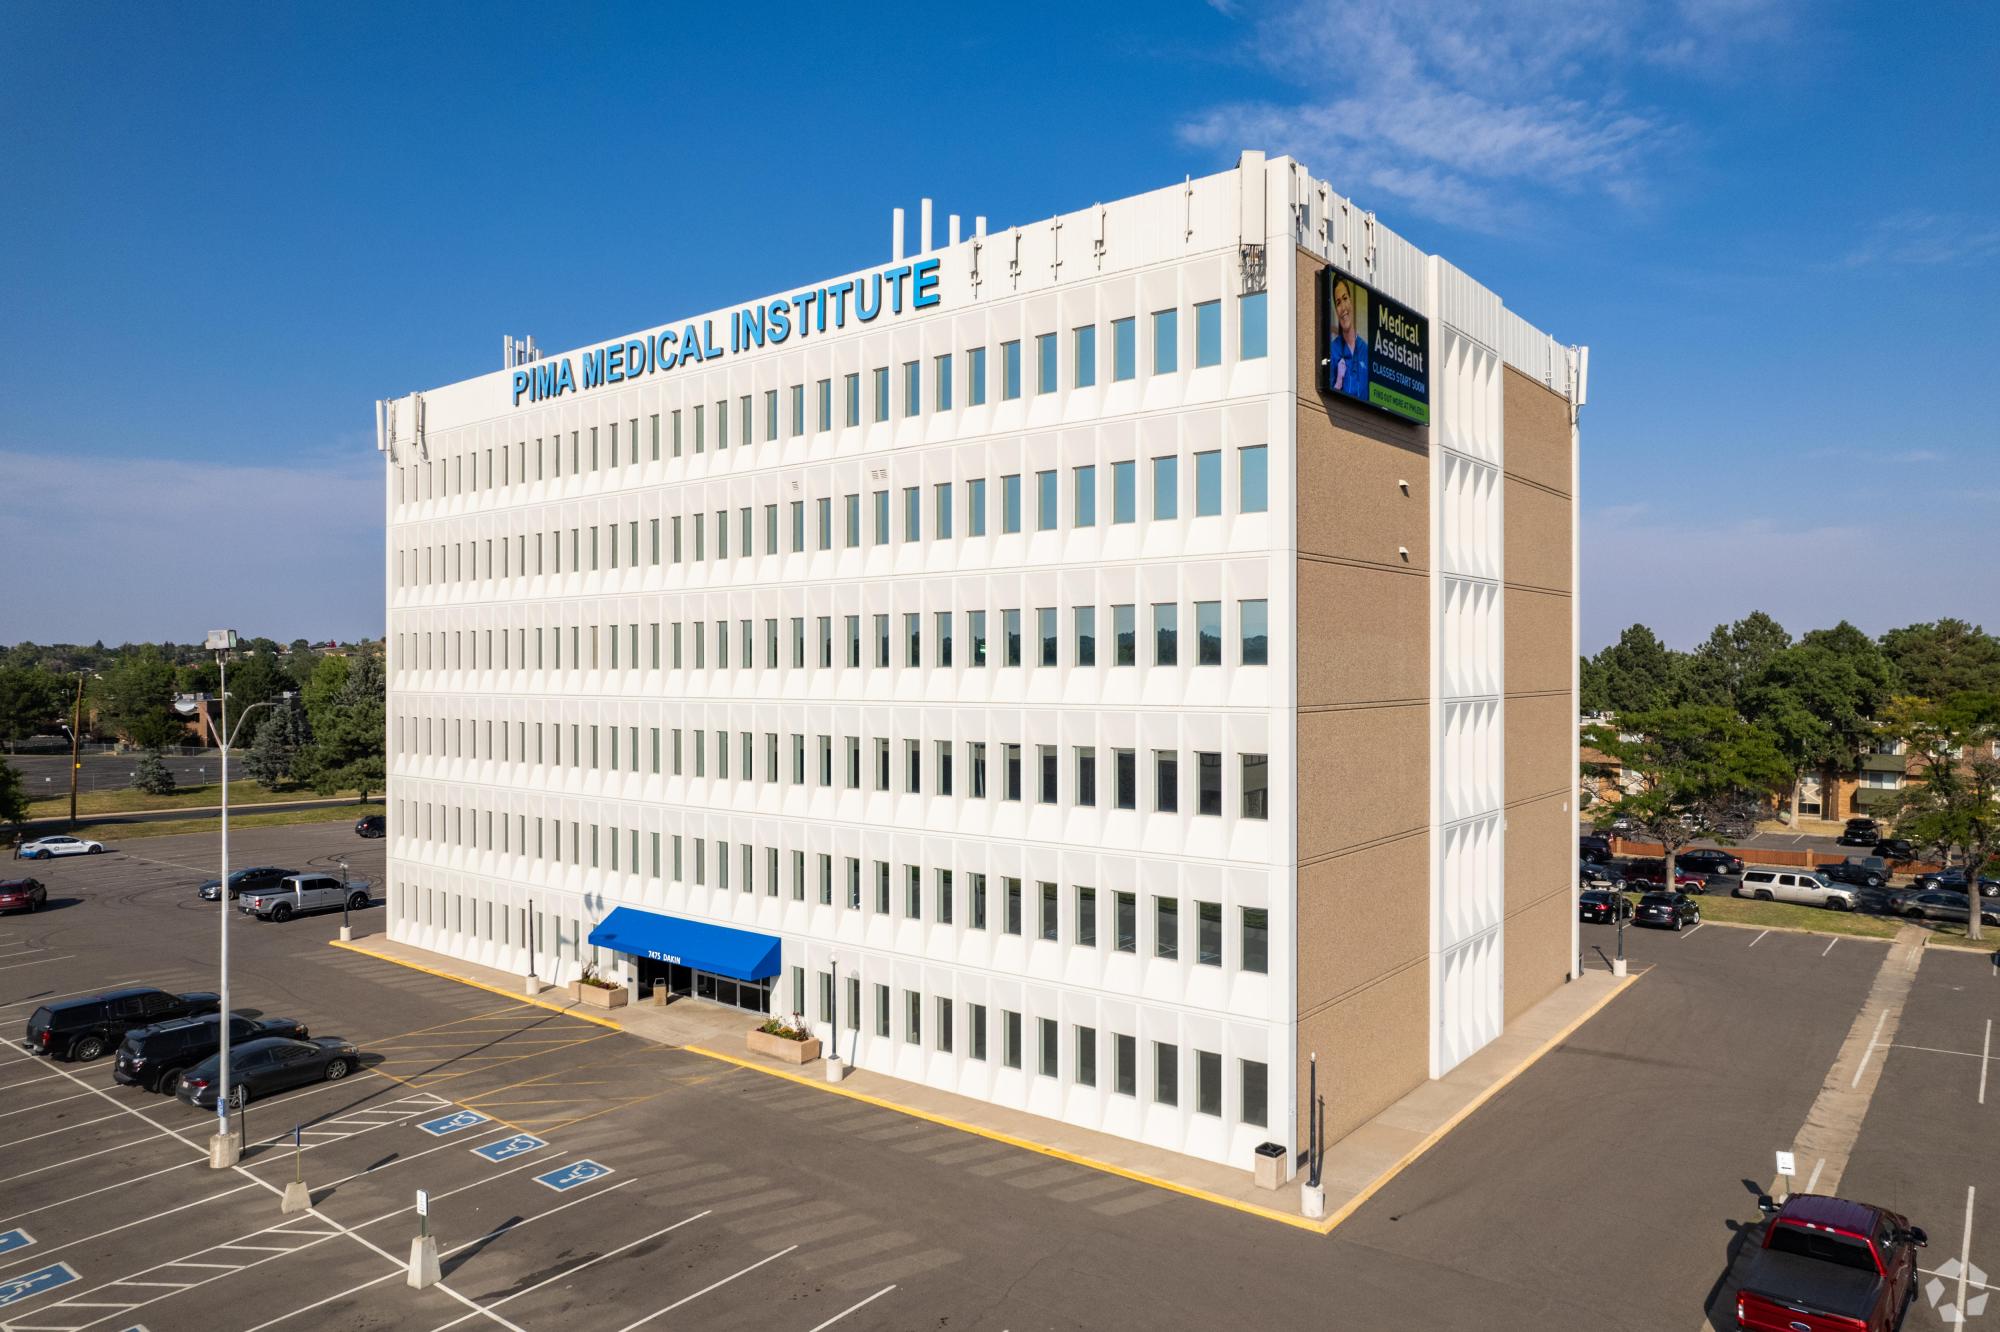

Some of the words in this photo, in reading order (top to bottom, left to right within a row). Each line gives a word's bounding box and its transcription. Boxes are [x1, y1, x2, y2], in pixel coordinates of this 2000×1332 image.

[512, 358, 576, 407] PIMA
[582, 319, 724, 389] MEDICAL
[731, 258, 940, 354] INSTITUTE
[1379, 304, 1420, 346] Medical
[1374, 329, 1423, 373] Assistant
[1372, 361, 1396, 381] CLASSES
[1396, 372, 1411, 387] START
[1412, 379, 1425, 394] SOON
[648, 950, 661, 960] 7475
[663, 953, 681, 964] DAKIN
